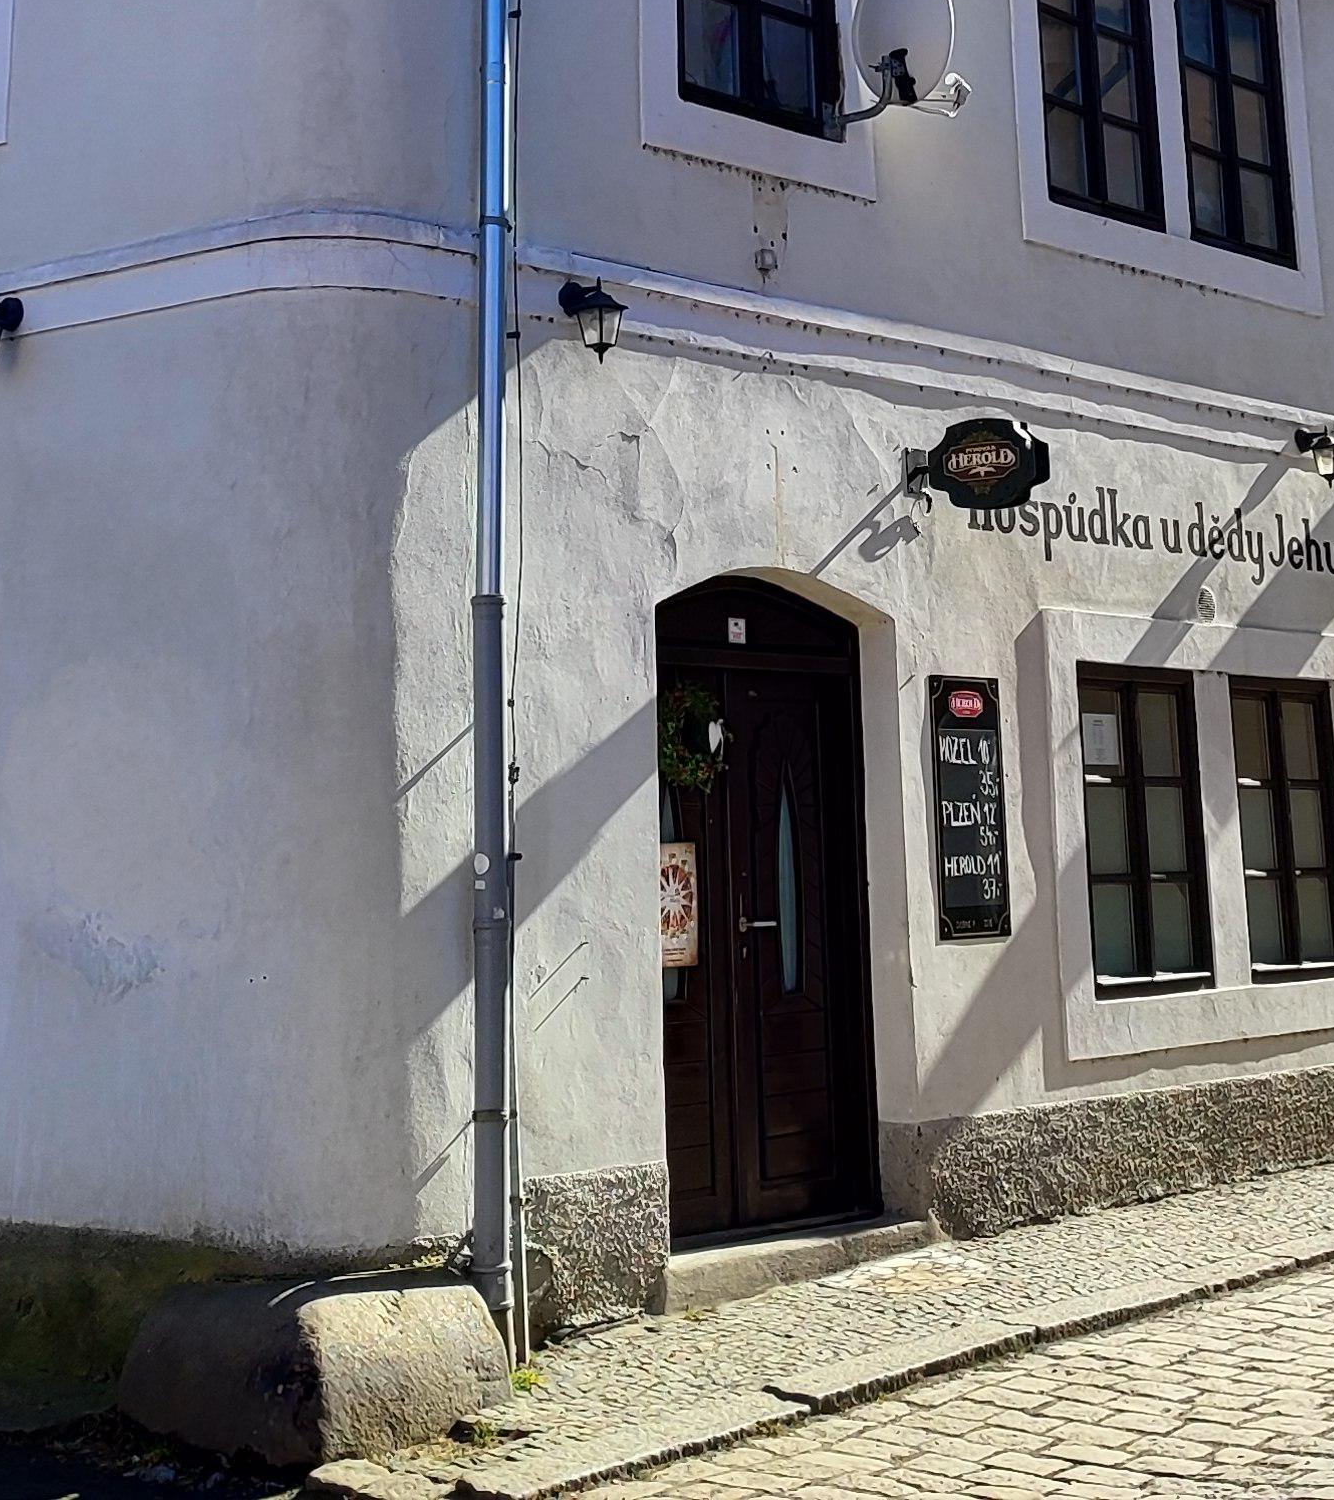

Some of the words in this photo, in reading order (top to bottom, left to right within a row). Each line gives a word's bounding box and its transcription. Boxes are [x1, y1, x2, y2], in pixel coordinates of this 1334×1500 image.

[949, 448, 1015, 470] HEROLD
[1160, 517, 1183, 554] u
[1188, 501, 1265, 586] dědy
[944, 855, 986, 877] HEROLD
